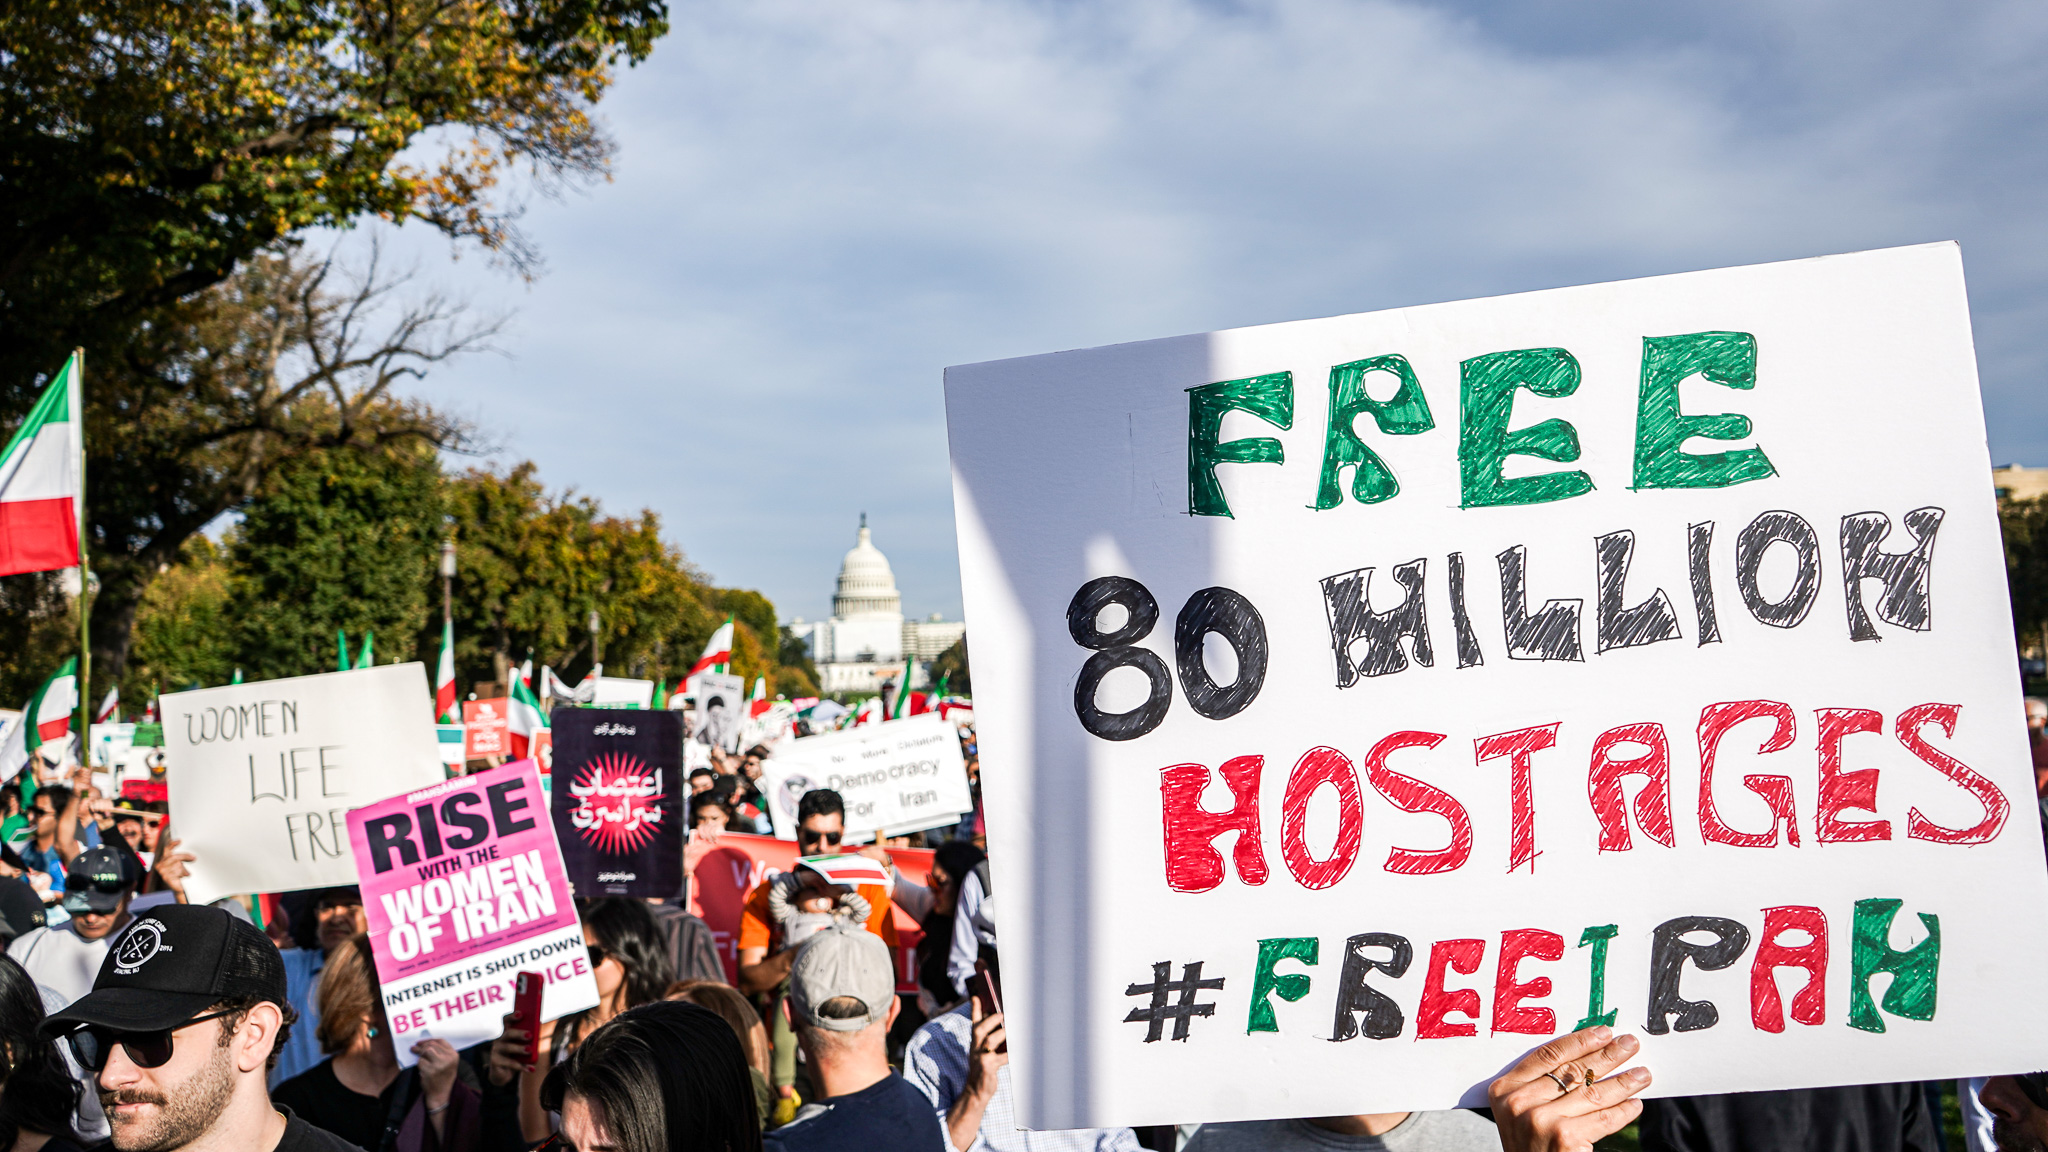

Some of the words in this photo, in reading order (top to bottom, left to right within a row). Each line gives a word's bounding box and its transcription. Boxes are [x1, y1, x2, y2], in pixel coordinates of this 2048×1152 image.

[1185, 330, 1777, 520] FREE
[1066, 576, 1269, 742] 80
[1319, 506, 1946, 691] MILLION
[184, 700, 298, 746] WOMEN
[249, 745, 349, 804] LIFE
[570, 767, 663, 803] اعتصاب
[827, 759, 940, 793] Democracy
[899, 789, 938, 808] Iran
[1158, 699, 2011, 895] HOSTAGES
[364, 777, 536, 875] RISE
[418, 855, 462, 880] WITH
[466, 845, 500, 866] THE
[379, 849, 547, 927] WOMEN
[388, 913, 443, 962] OF
[451, 879, 557, 943] IRAN
[386, 971, 463, 1006] INTERNET
[467, 966, 482, 980] IS
[486, 952, 527, 975] SHUT
[530, 935, 582, 961] DOWN
[393, 1009, 427, 1034] BE
[429, 984, 505, 1021] THEIR
[508, 956, 588, 995] ICE
[1123, 897, 1940, 1044] #FREEIRAN
